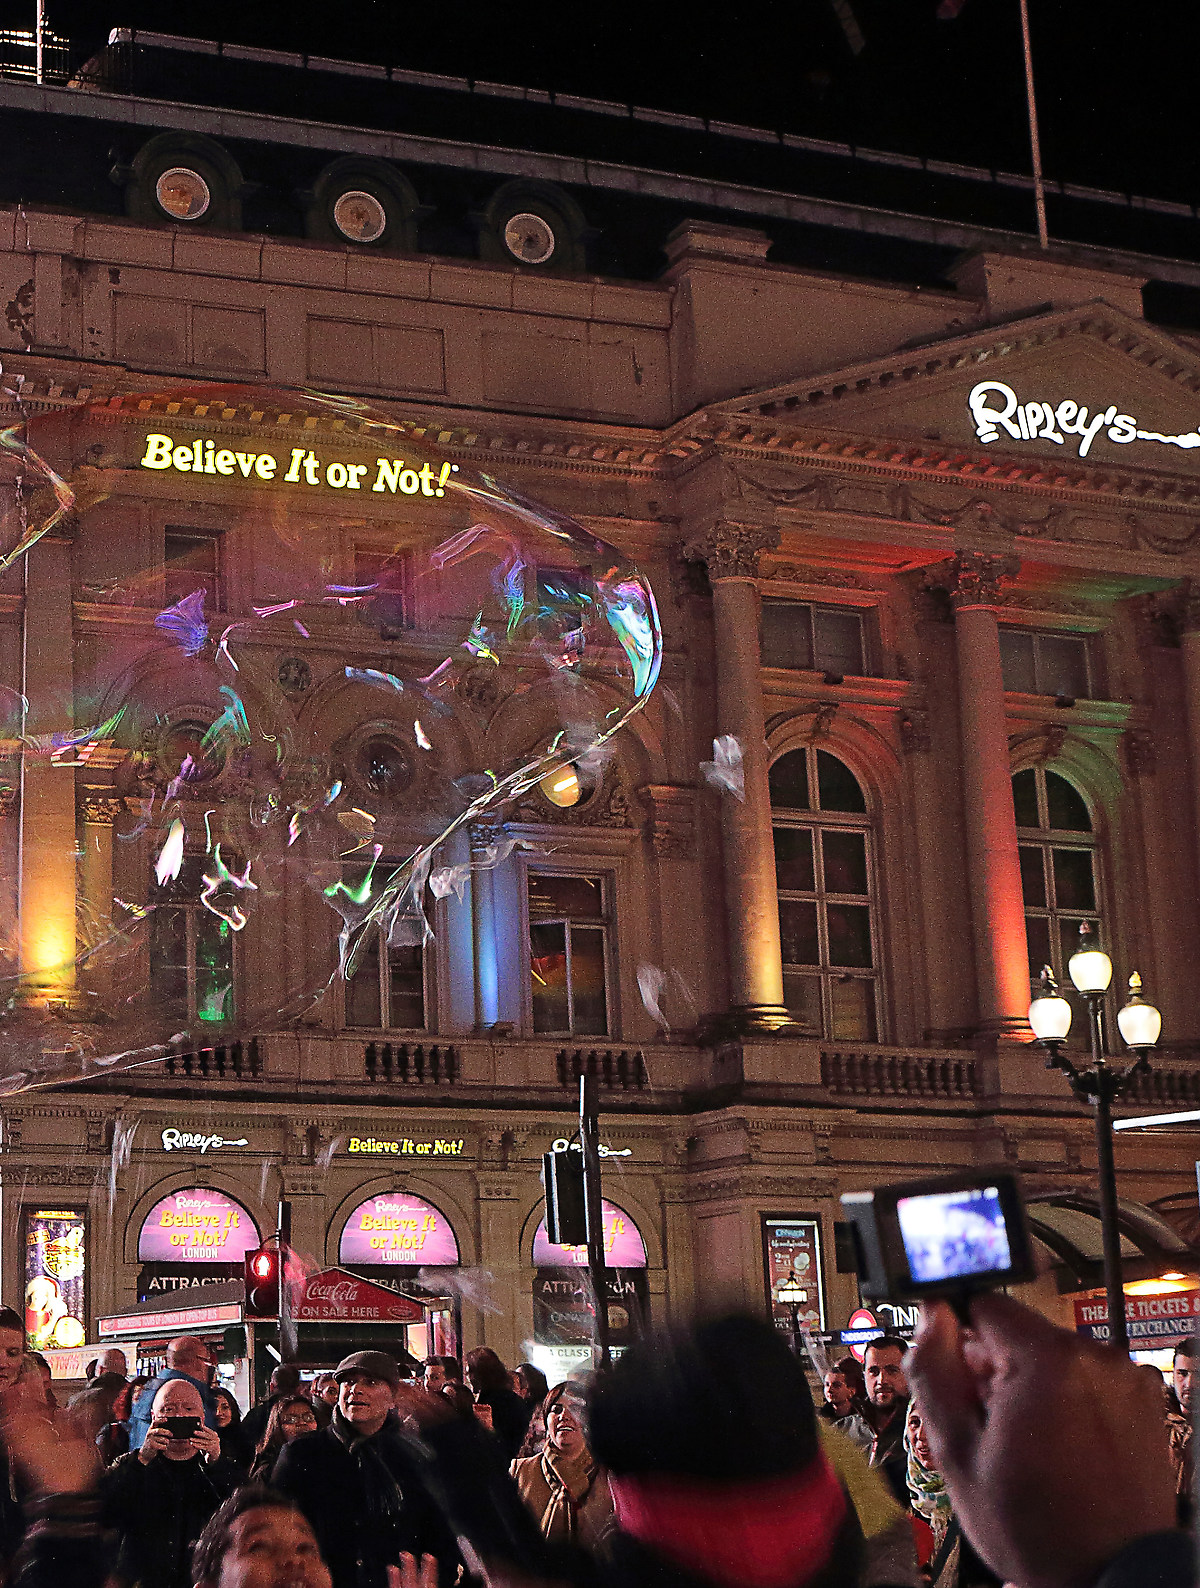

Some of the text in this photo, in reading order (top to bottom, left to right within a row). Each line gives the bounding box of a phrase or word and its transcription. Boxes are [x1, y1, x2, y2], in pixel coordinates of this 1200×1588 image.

[141, 434, 451, 497] Believe It or Not!
[348, 1137, 464, 1155] Believe It or Not!
[159, 1209, 240, 1228] Believe It
[360, 1214, 437, 1231] Believe It
[611, 1217, 624, 1234] It
[170, 1229, 229, 1247] or Not!
[370, 1232, 425, 1249] or Not!
[182, 1247, 218, 1259] LONDON
[382, 1250, 416, 1261] LONDON
[302, 1306, 319, 1316] ON
[322, 1306, 348, 1317] SALE
[351, 1306, 380, 1318] HERE
[1136, 1298, 1189, 1317] TICKETS
[1131, 1319, 1196, 1336] EXCHANGE
[557, 1348, 589, 1358] CLASS
